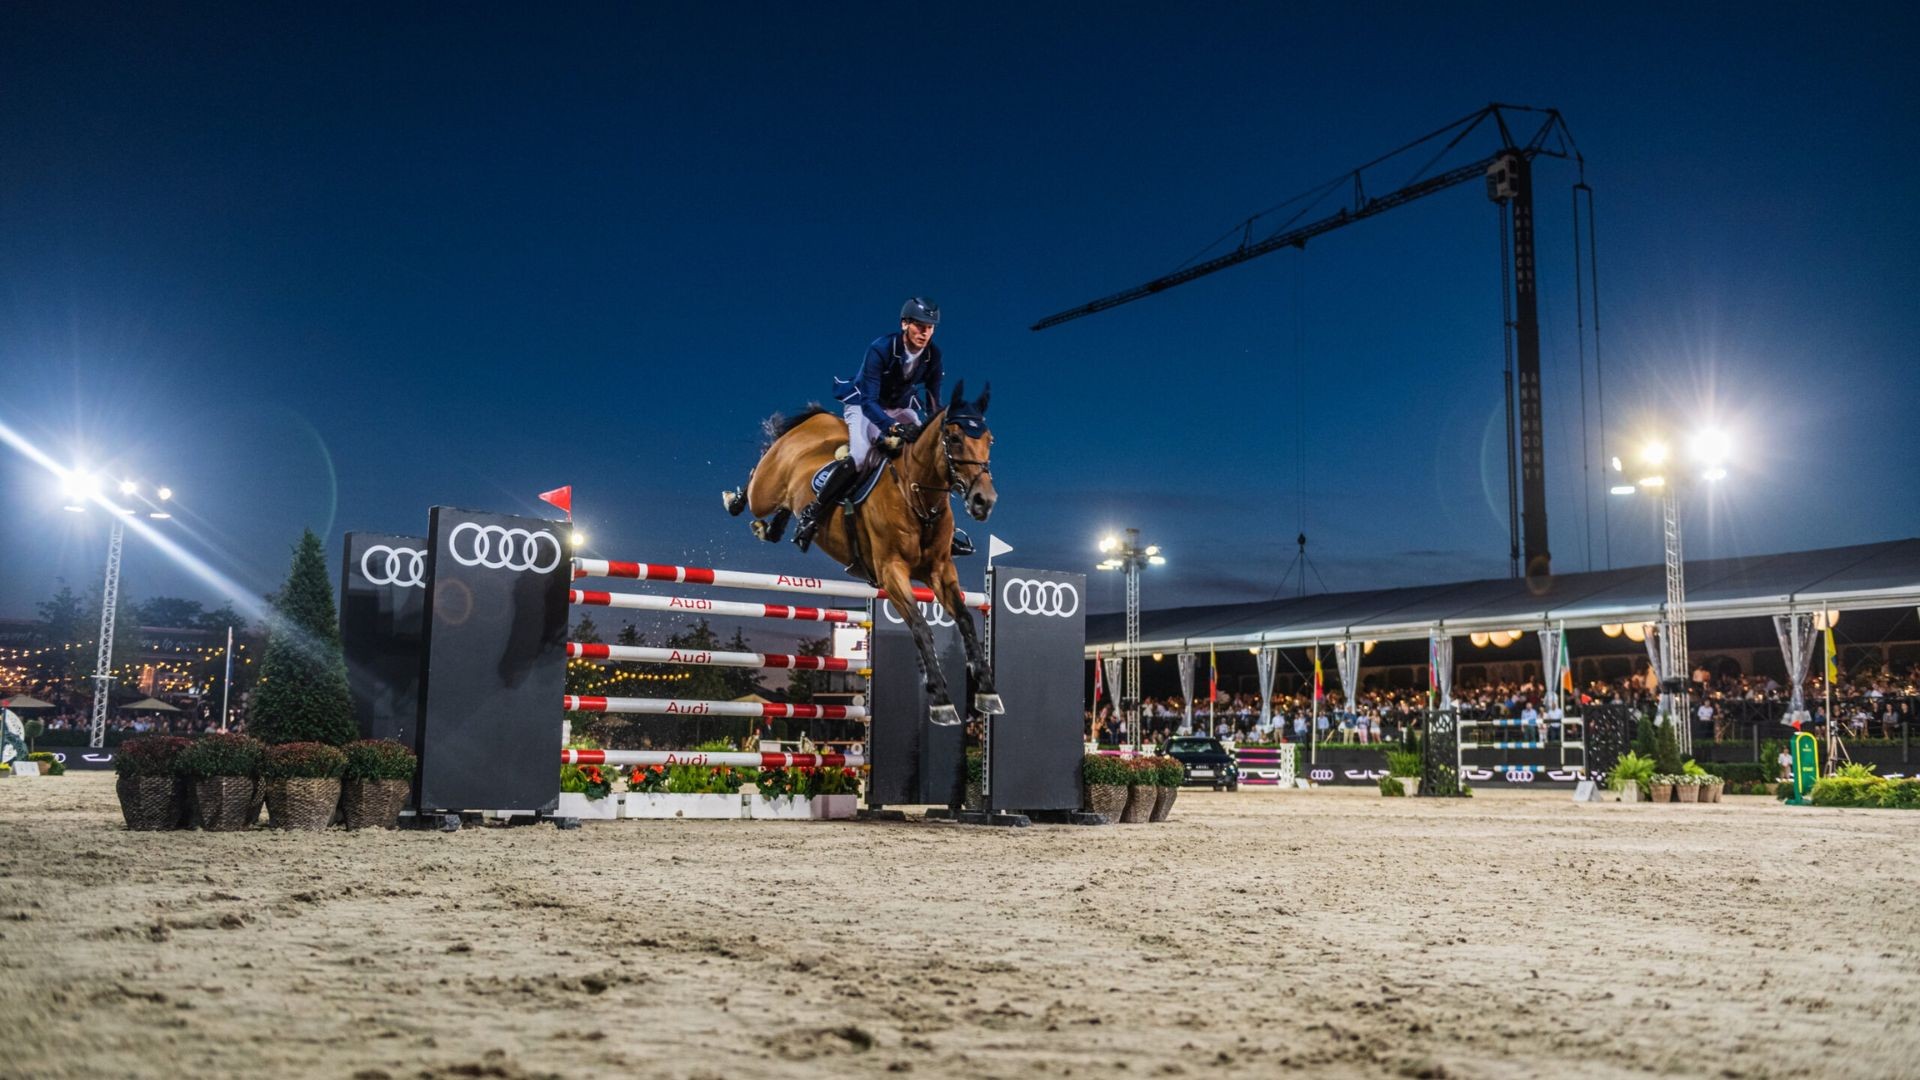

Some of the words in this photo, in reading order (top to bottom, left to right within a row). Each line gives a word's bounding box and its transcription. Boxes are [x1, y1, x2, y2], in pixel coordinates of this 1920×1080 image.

[1521, 372, 1530, 480] ANTHONY
[1531, 372, 1541, 480] ANTHONY
[777, 574, 822, 589] Audi
[669, 596, 712, 610] Audi
[668, 650, 711, 664] Audi
[665, 701, 709, 714] Audi
[664, 753, 707, 766] Audi
